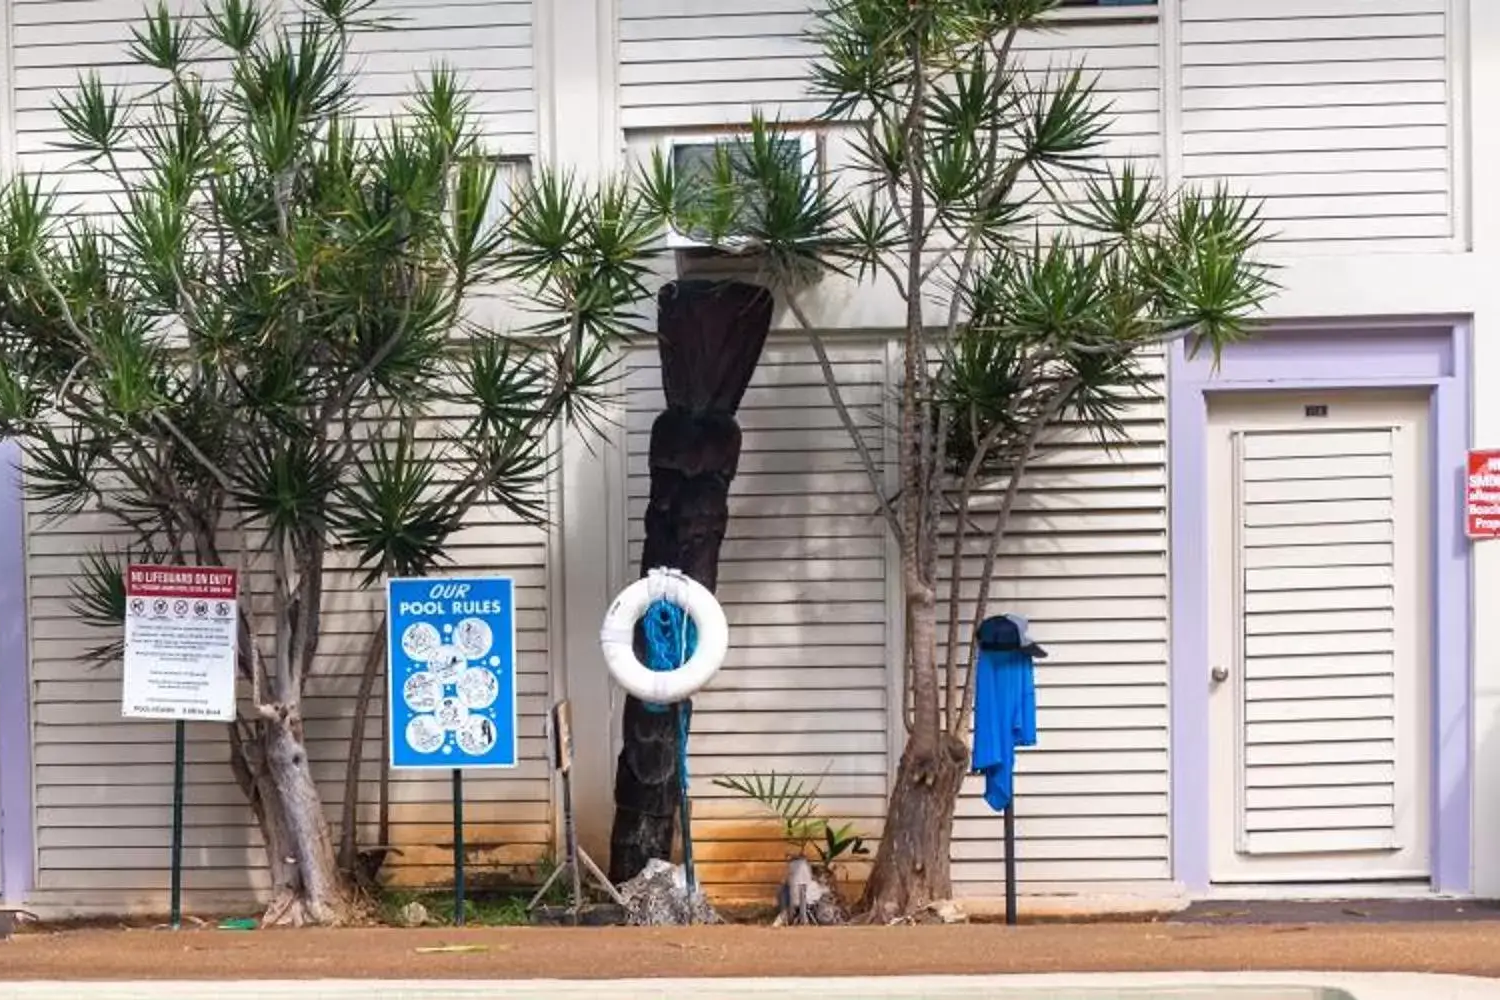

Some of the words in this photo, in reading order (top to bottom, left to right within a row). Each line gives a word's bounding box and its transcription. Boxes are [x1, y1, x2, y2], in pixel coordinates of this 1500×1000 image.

[131, 571, 144, 582] NO
[145, 572, 193, 584] LIFEGUARD
[194, 573, 207, 585] ON
[209, 574, 233, 585] DUTY
[429, 584, 471, 599] OUR
[399, 602, 446, 615] POOL
[452, 600, 501, 614] RULES
